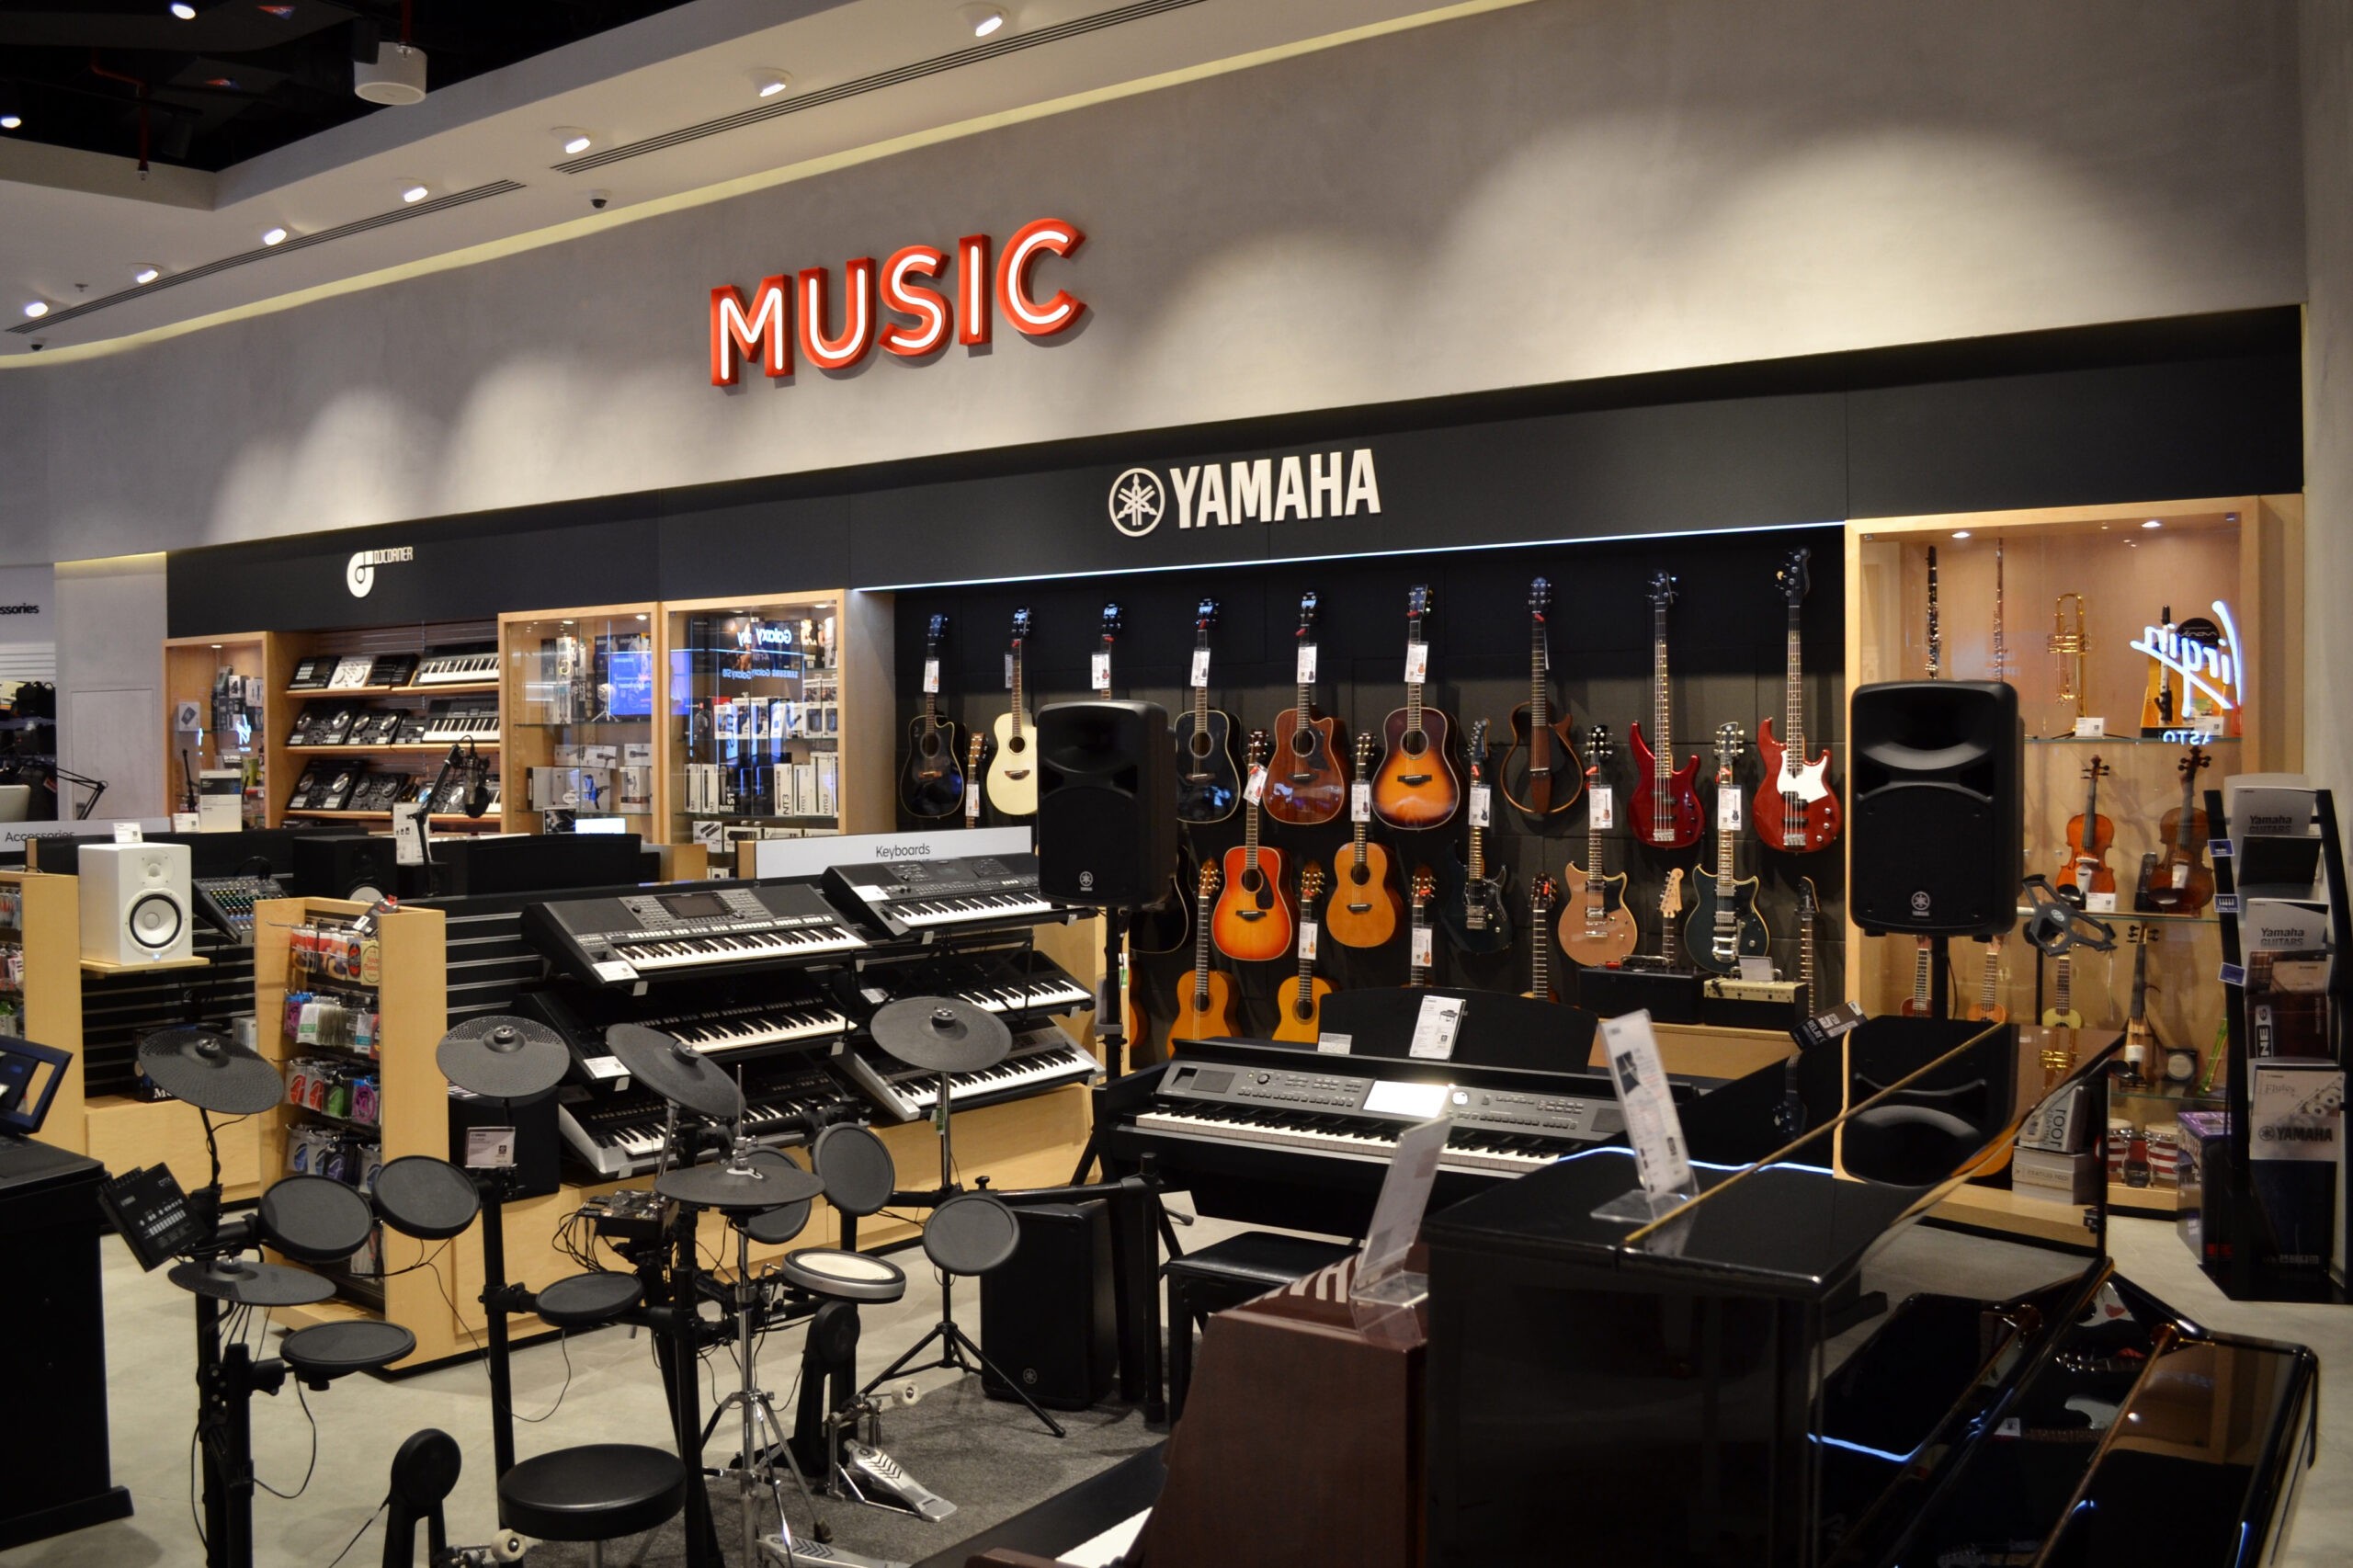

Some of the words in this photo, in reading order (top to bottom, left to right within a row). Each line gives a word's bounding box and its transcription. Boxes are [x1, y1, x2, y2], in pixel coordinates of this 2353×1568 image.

[710, 218, 1087, 386] MUSIC
[1169, 449, 1381, 529] YAMAHA
[876, 843, 931, 860] Keyboards
[2260, 927, 2305, 937] Yamaha
[2276, 1126, 2333, 1142] YAMAHA
